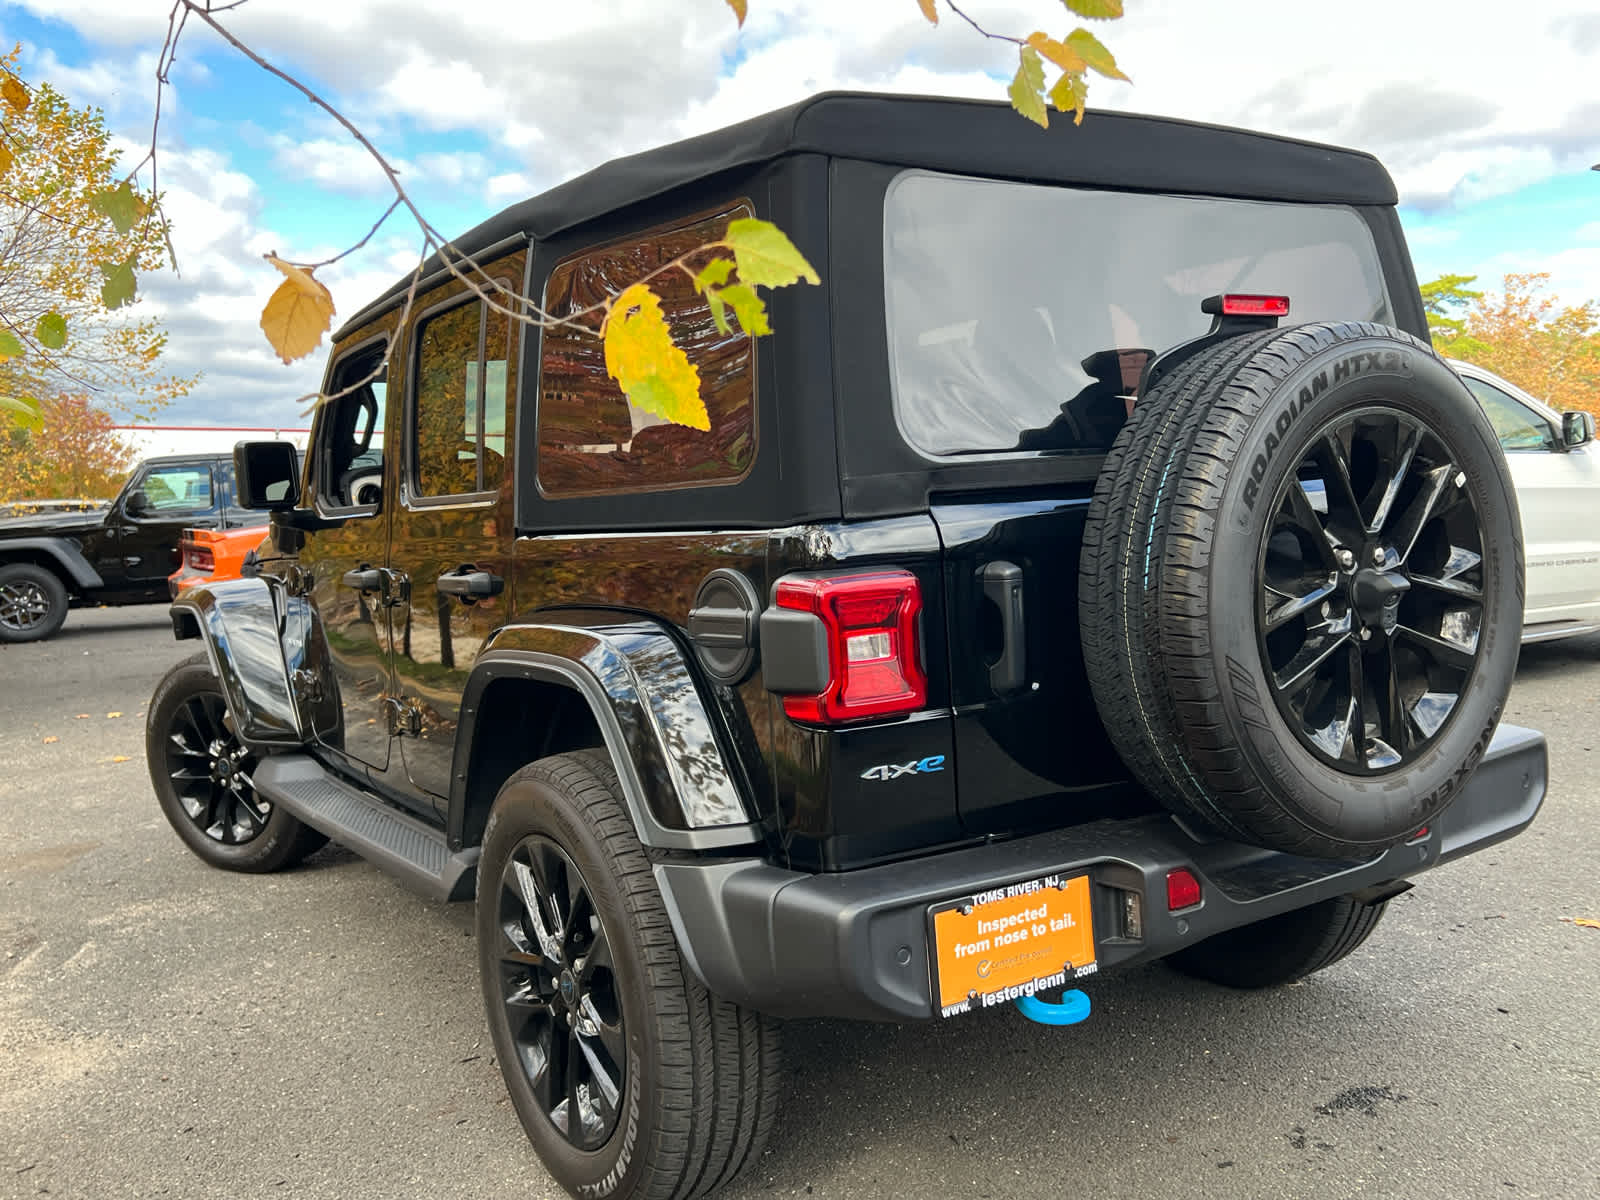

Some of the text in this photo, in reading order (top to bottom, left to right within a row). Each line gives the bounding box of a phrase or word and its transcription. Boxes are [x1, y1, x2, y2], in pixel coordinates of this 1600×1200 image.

[1242, 371, 1329, 511] ROADIAN
[971, 874, 1059, 907] TOMS RIVER, NJ
[954, 936, 990, 959] from
[994, 929, 1028, 950] nose
[1031, 922, 1046, 939] to
[1049, 912, 1076, 933] tail.
[977, 903, 1047, 935] Inspected
